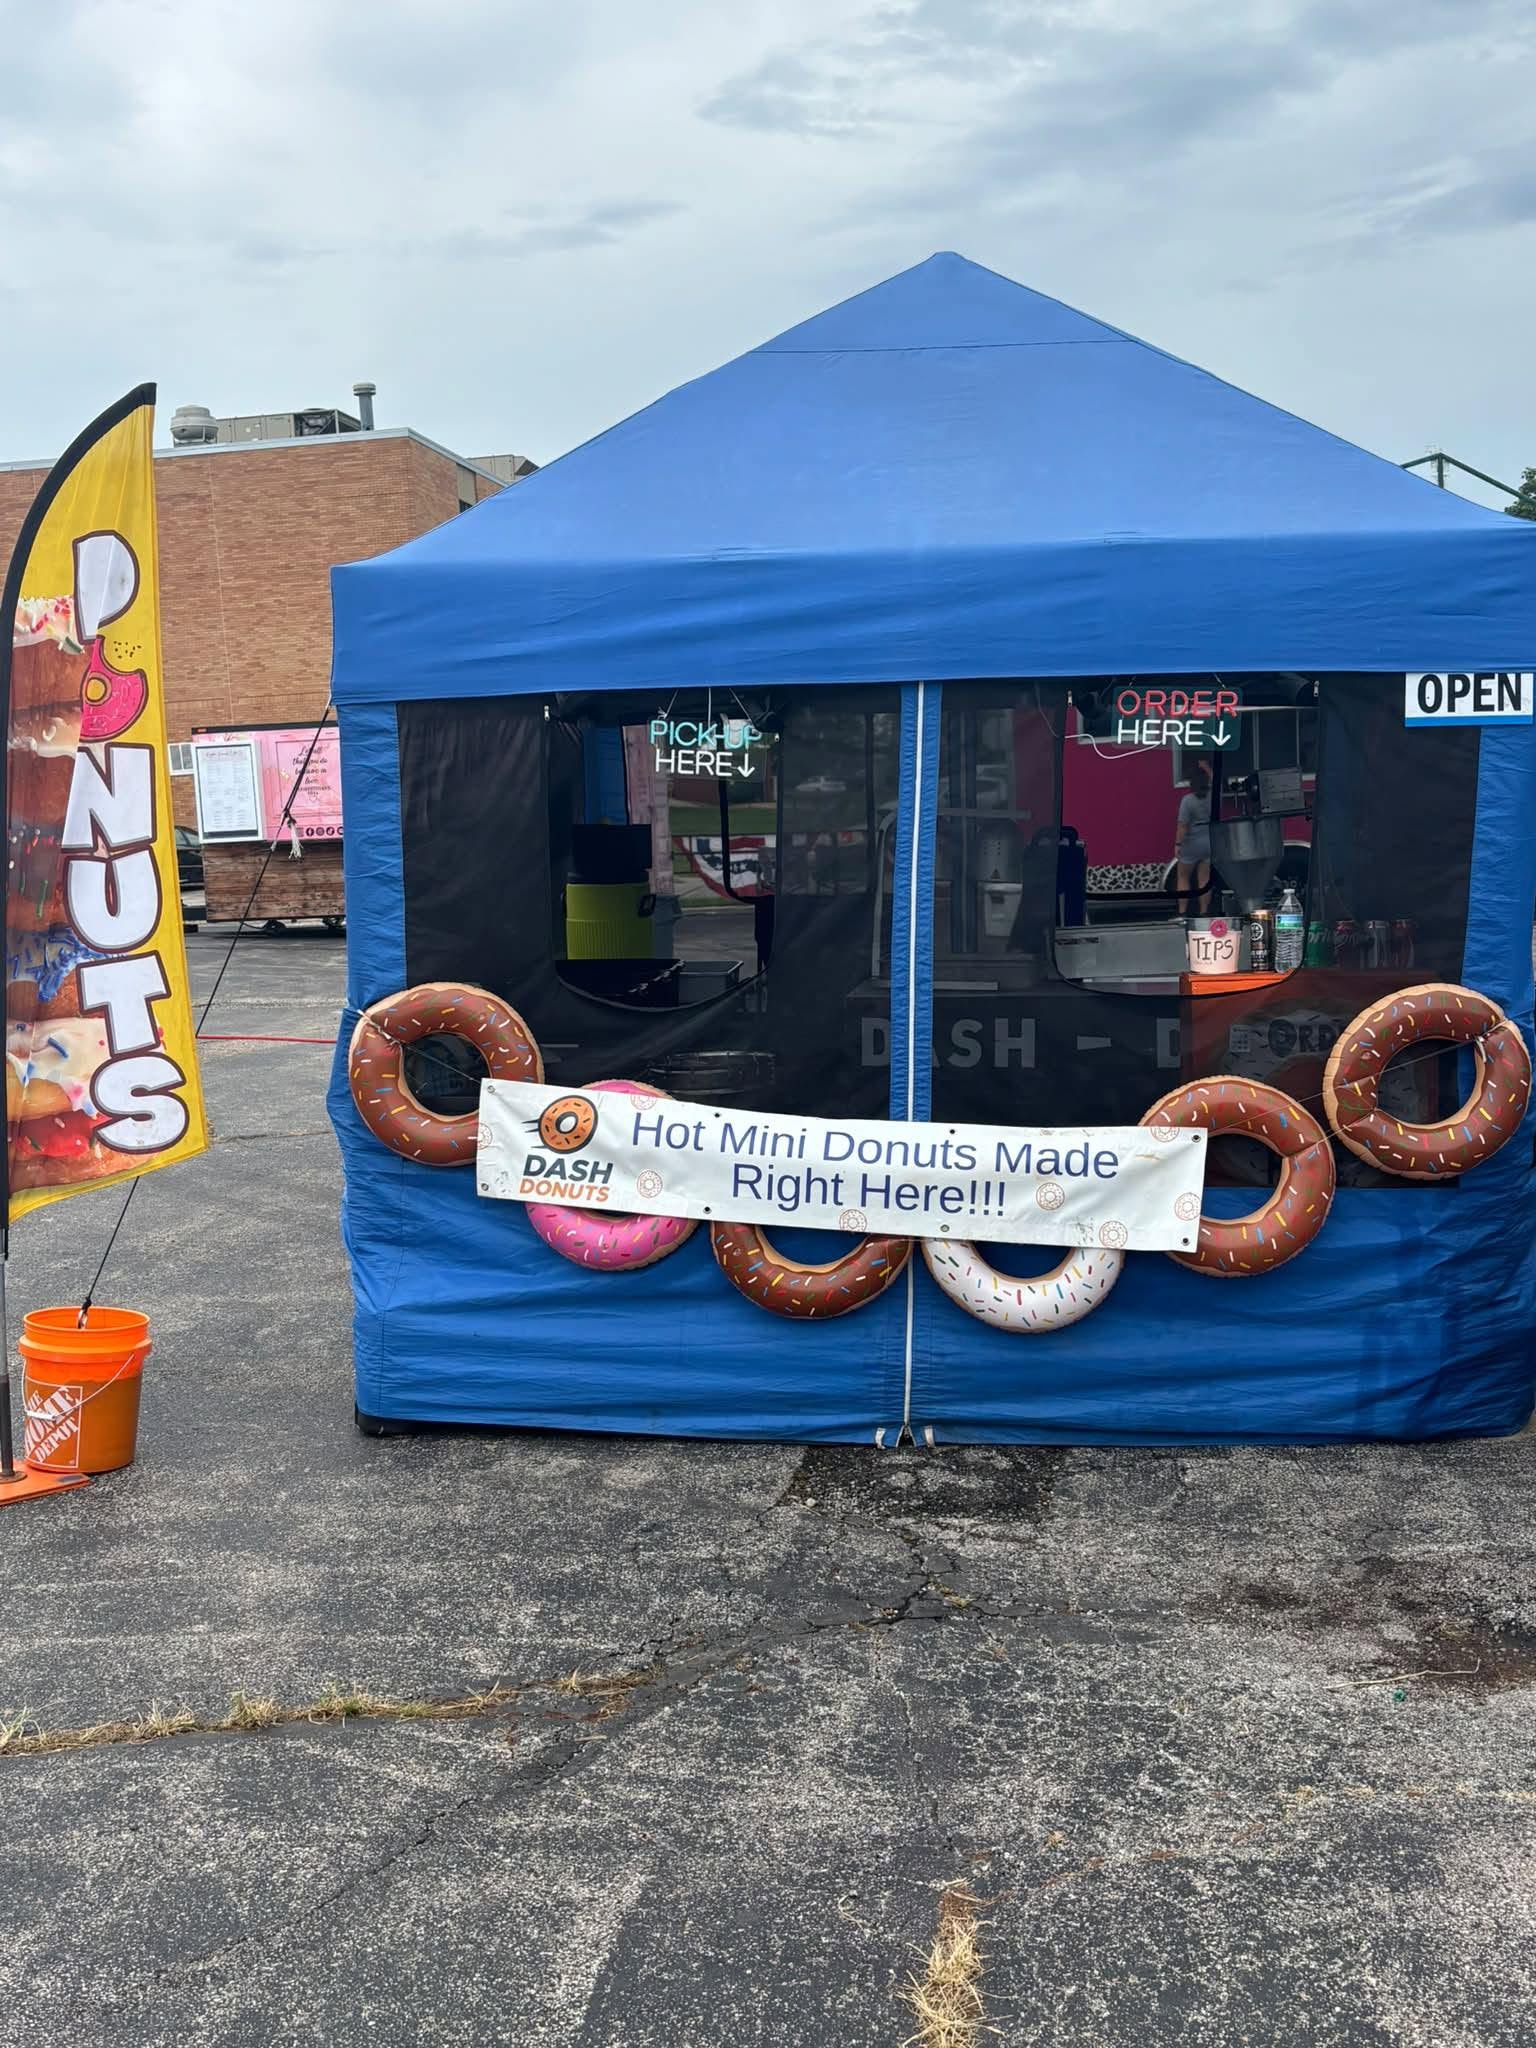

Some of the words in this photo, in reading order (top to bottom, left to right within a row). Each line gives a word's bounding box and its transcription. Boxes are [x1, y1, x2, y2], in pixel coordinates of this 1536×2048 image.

[1116, 689, 1239, 718] ORDER
[1417, 672, 1522, 714] OPEN
[649, 719, 763, 750] PICK-UP
[1117, 719, 1205, 746] HERE
[655, 748, 733, 777] HERE
[61, 530, 189, 1156] DONUTS
[1192, 937, 1234, 961] TIPS
[860, 1016, 1036, 1069] DSH
[632, 1112, 704, 1151] Hot
[720, 1122, 808, 1159] Mini
[823, 1130, 978, 1171] Donuts
[994, 1141, 1119, 1179] Made
[523, 1154, 614, 1185] DASH
[519, 1178, 610, 1202] DONUTS
[732, 1163, 844, 1212] Right
[860, 1172, 1006, 1217] Here!!!
[35, 1416, 79, 1463] DEPOT
